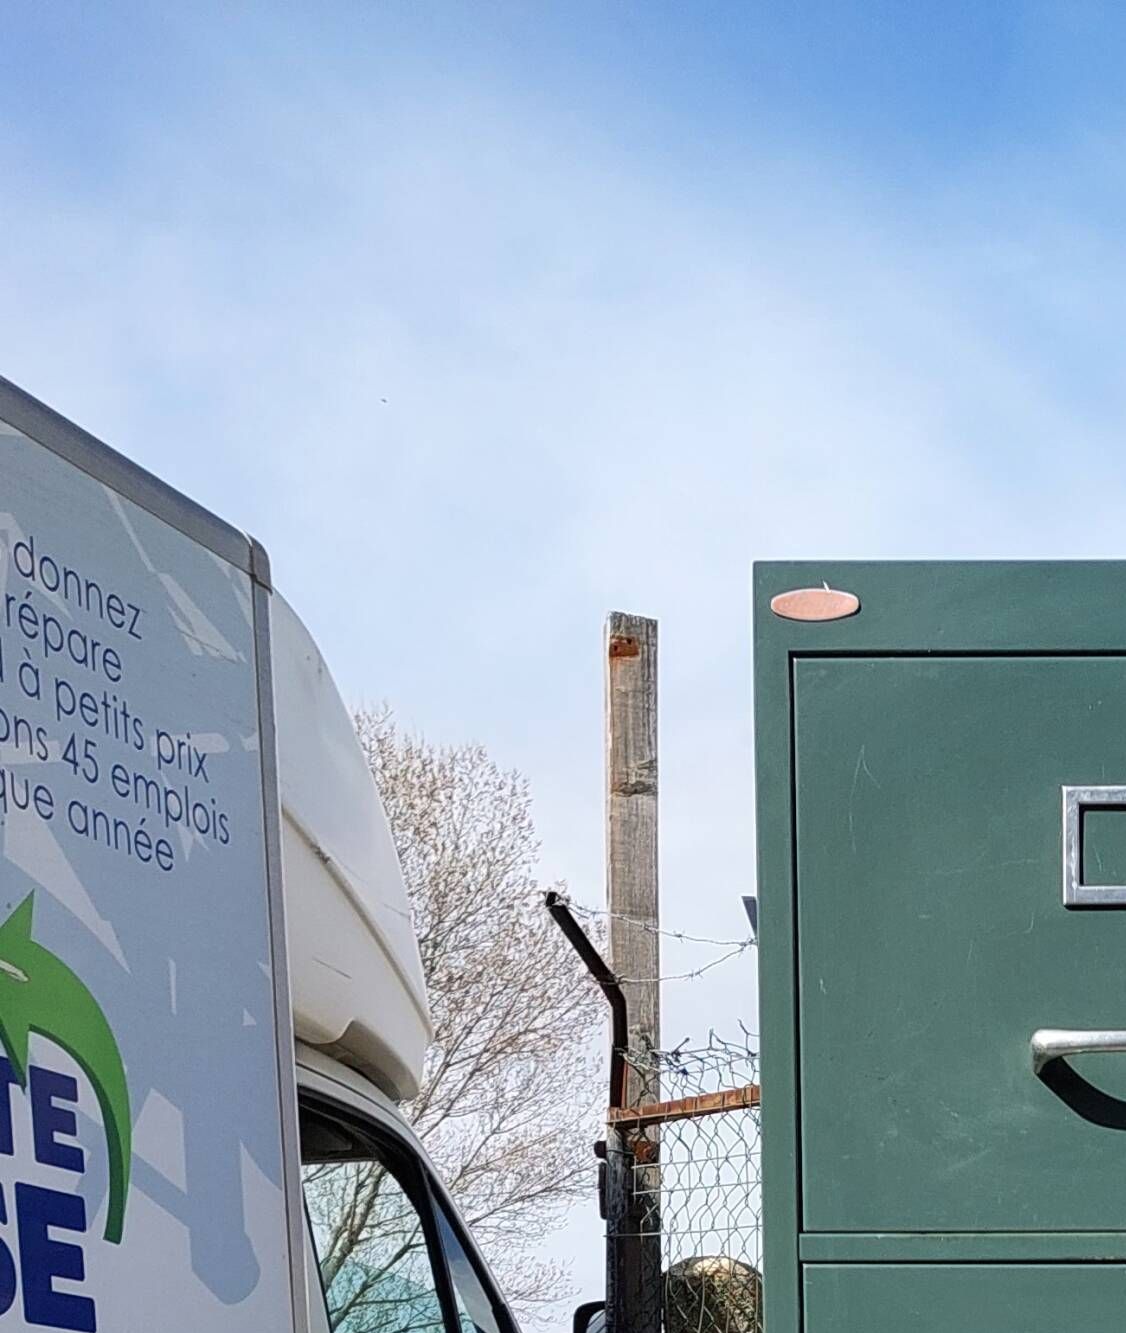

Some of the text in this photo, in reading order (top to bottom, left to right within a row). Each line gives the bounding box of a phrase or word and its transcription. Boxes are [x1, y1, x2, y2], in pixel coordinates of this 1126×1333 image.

[5, 591, 122, 682] répare
[13, 536, 143, 640] donnez
[19, 648, 41, 700] à
[55, 677, 145, 750] petits
[156, 728, 209, 783] prix
[62, 732, 99, 784] 45
[111, 764, 230, 845] emplois
[68, 800, 174, 871] année
